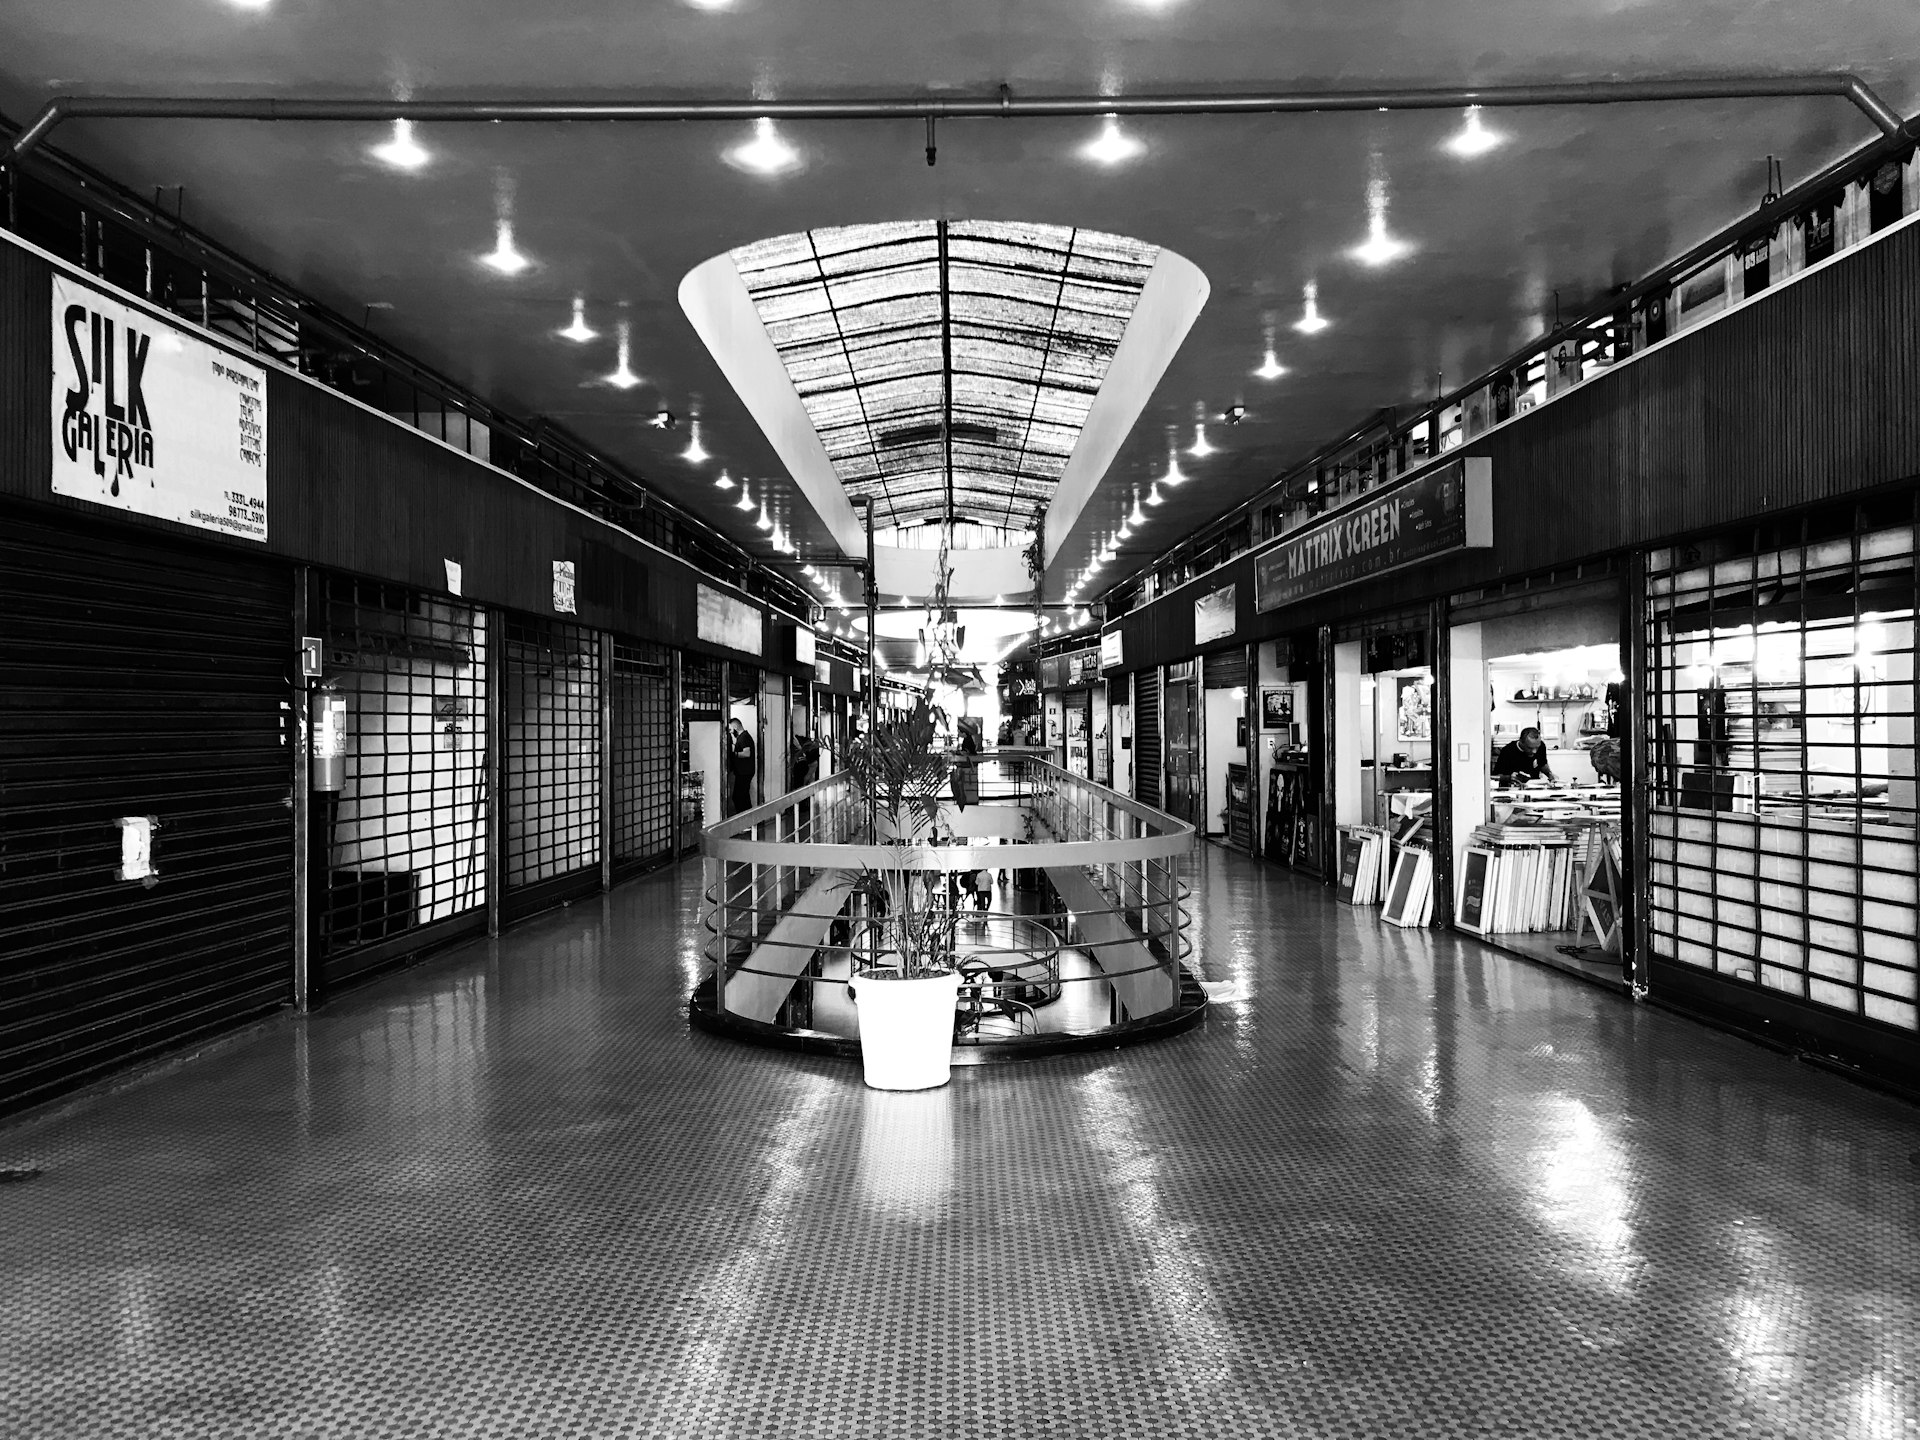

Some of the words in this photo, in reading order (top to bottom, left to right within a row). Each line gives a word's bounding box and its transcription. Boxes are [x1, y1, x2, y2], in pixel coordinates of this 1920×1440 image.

[64, 304, 151, 430] SILK
[62, 410, 154, 479] GALERIA
[239, 418, 262, 439] ADESIVOS
[1288, 524, 1343, 579] MATTRIX
[1345, 498, 1402, 558] SCREEN
